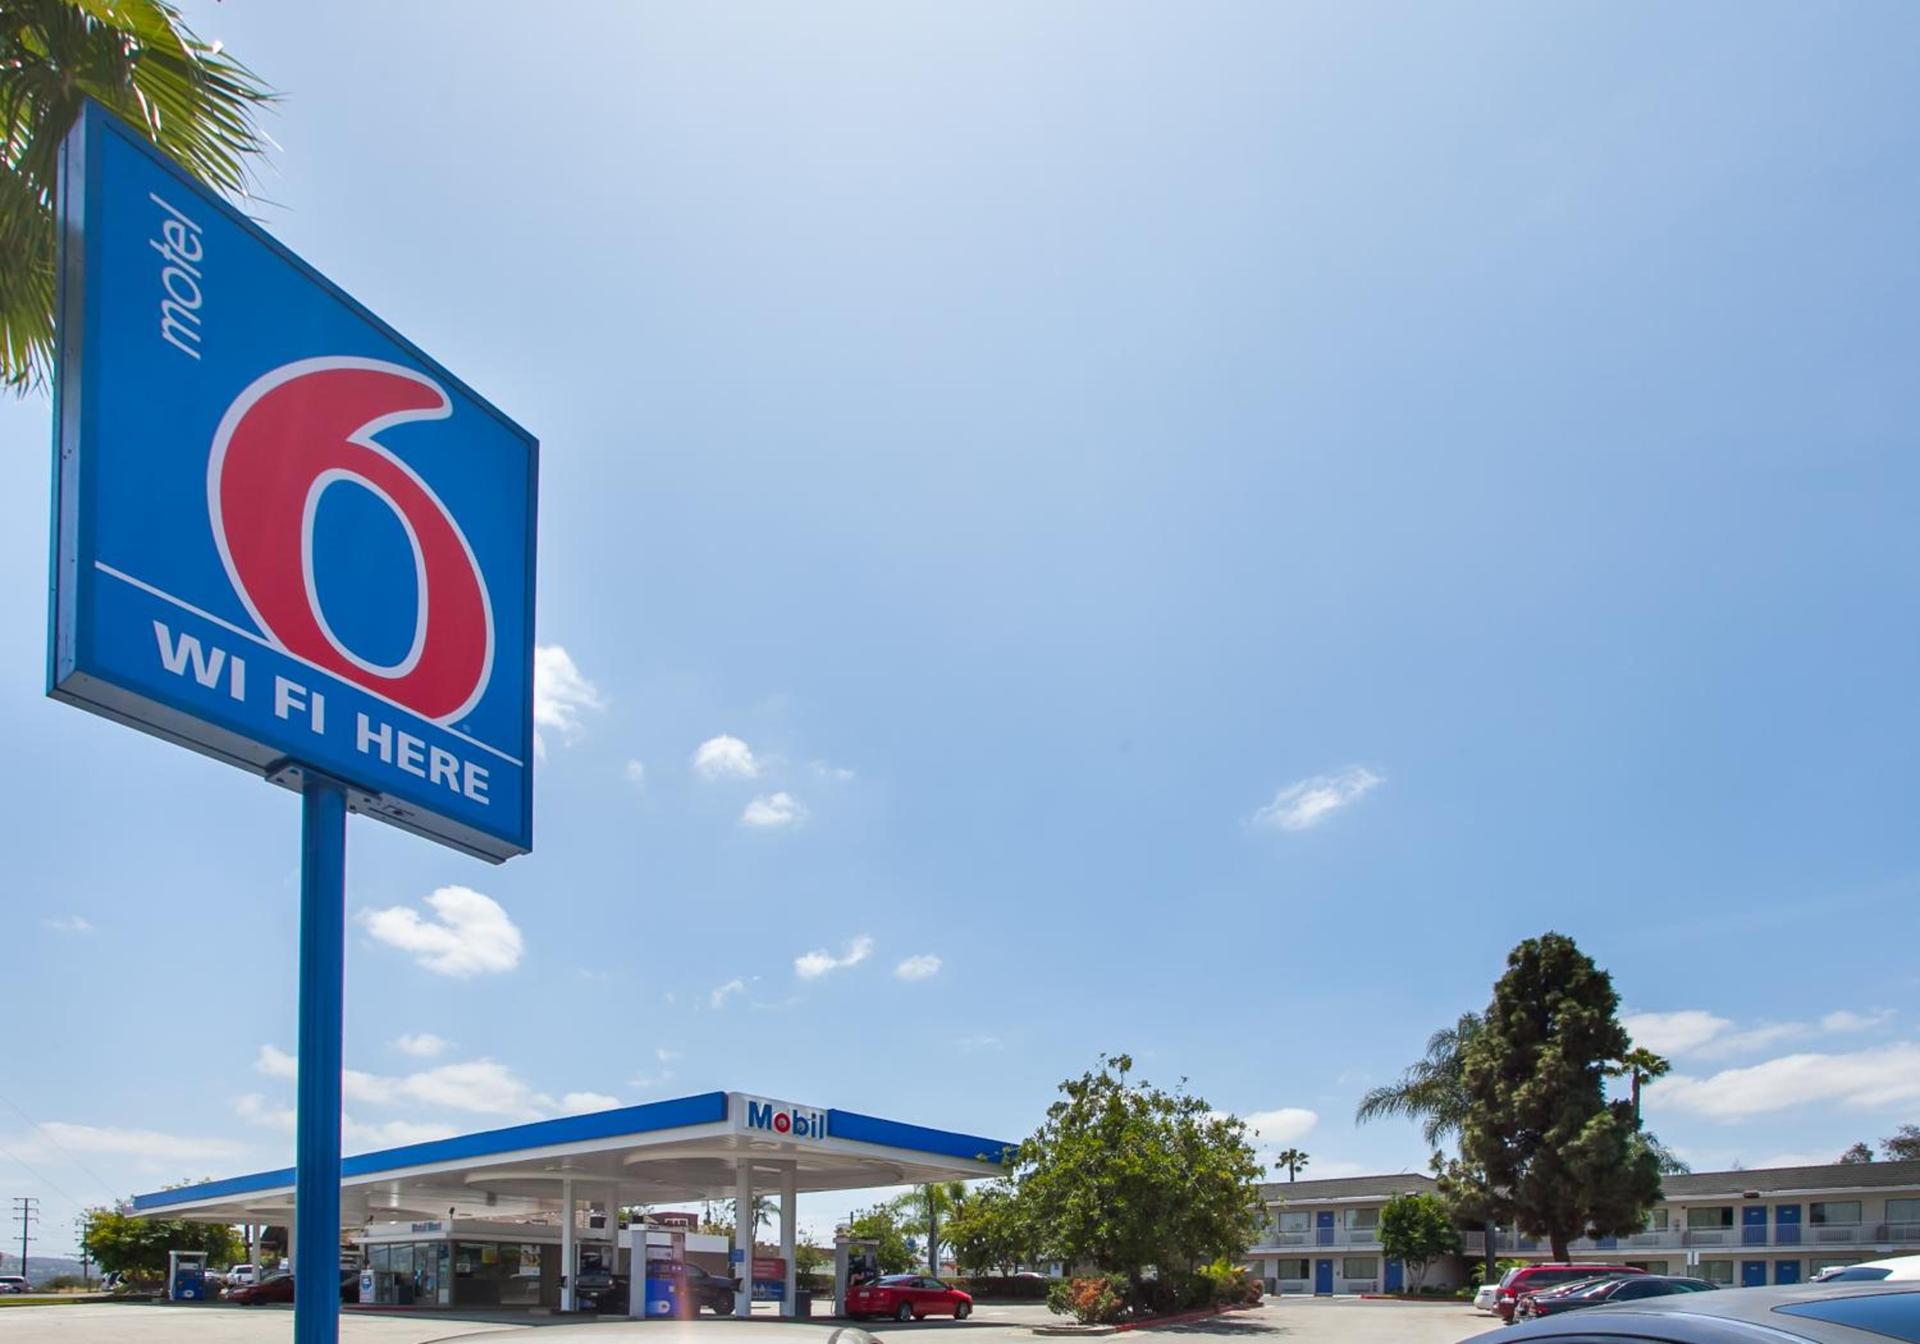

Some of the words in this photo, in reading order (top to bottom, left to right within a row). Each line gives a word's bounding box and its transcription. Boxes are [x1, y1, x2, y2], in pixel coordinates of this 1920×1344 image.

[149, 192, 203, 360] motel
[206, 355, 495, 728] 6
[153, 620, 246, 702] WI
[274, 675, 325, 735] FI
[357, 712, 490, 806] HERE
[748, 1101, 824, 1139] Mobil
